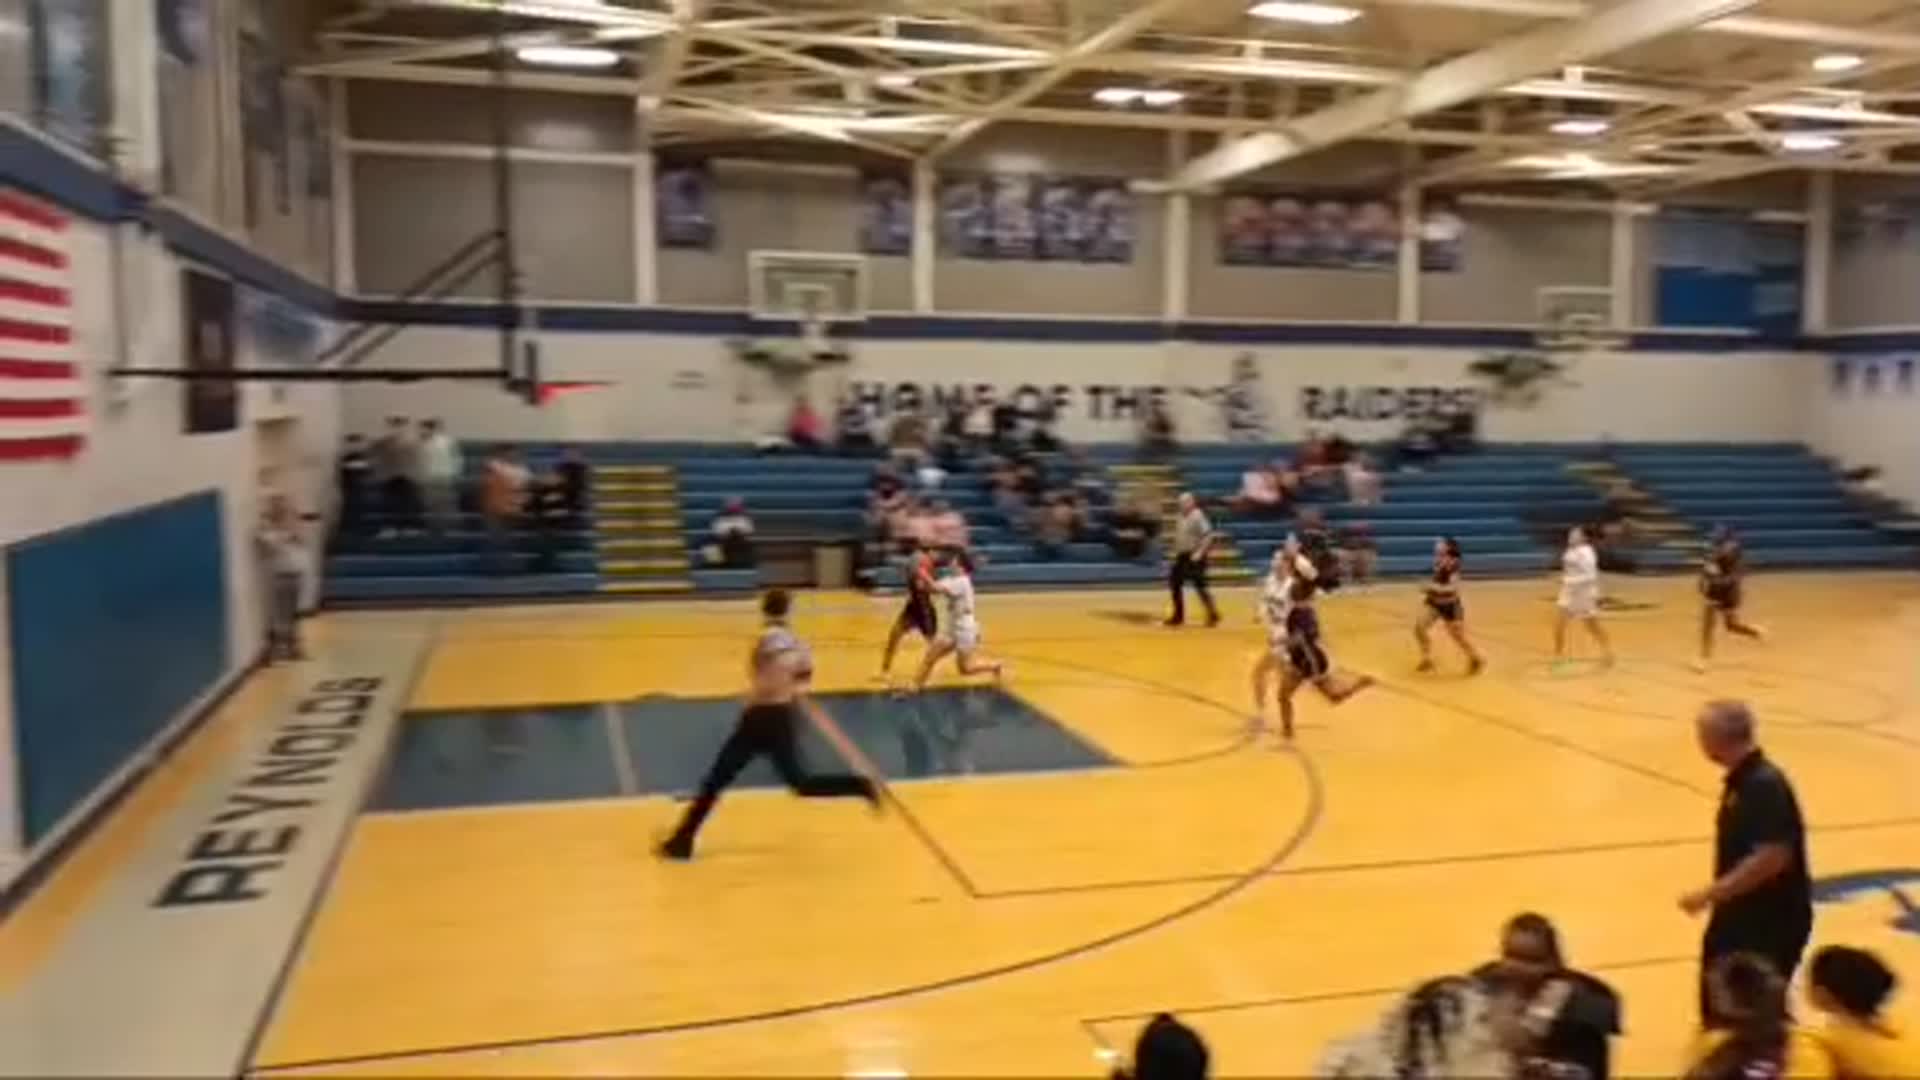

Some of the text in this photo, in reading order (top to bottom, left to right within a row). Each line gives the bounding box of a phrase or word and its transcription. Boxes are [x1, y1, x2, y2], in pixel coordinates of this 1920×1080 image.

[851, 383, 994, 419] HOME
[1011, 383, 1071, 420] OF
[1083, 384, 1168, 420] THE
[149, 677, 383, 907] REYNOLDS
